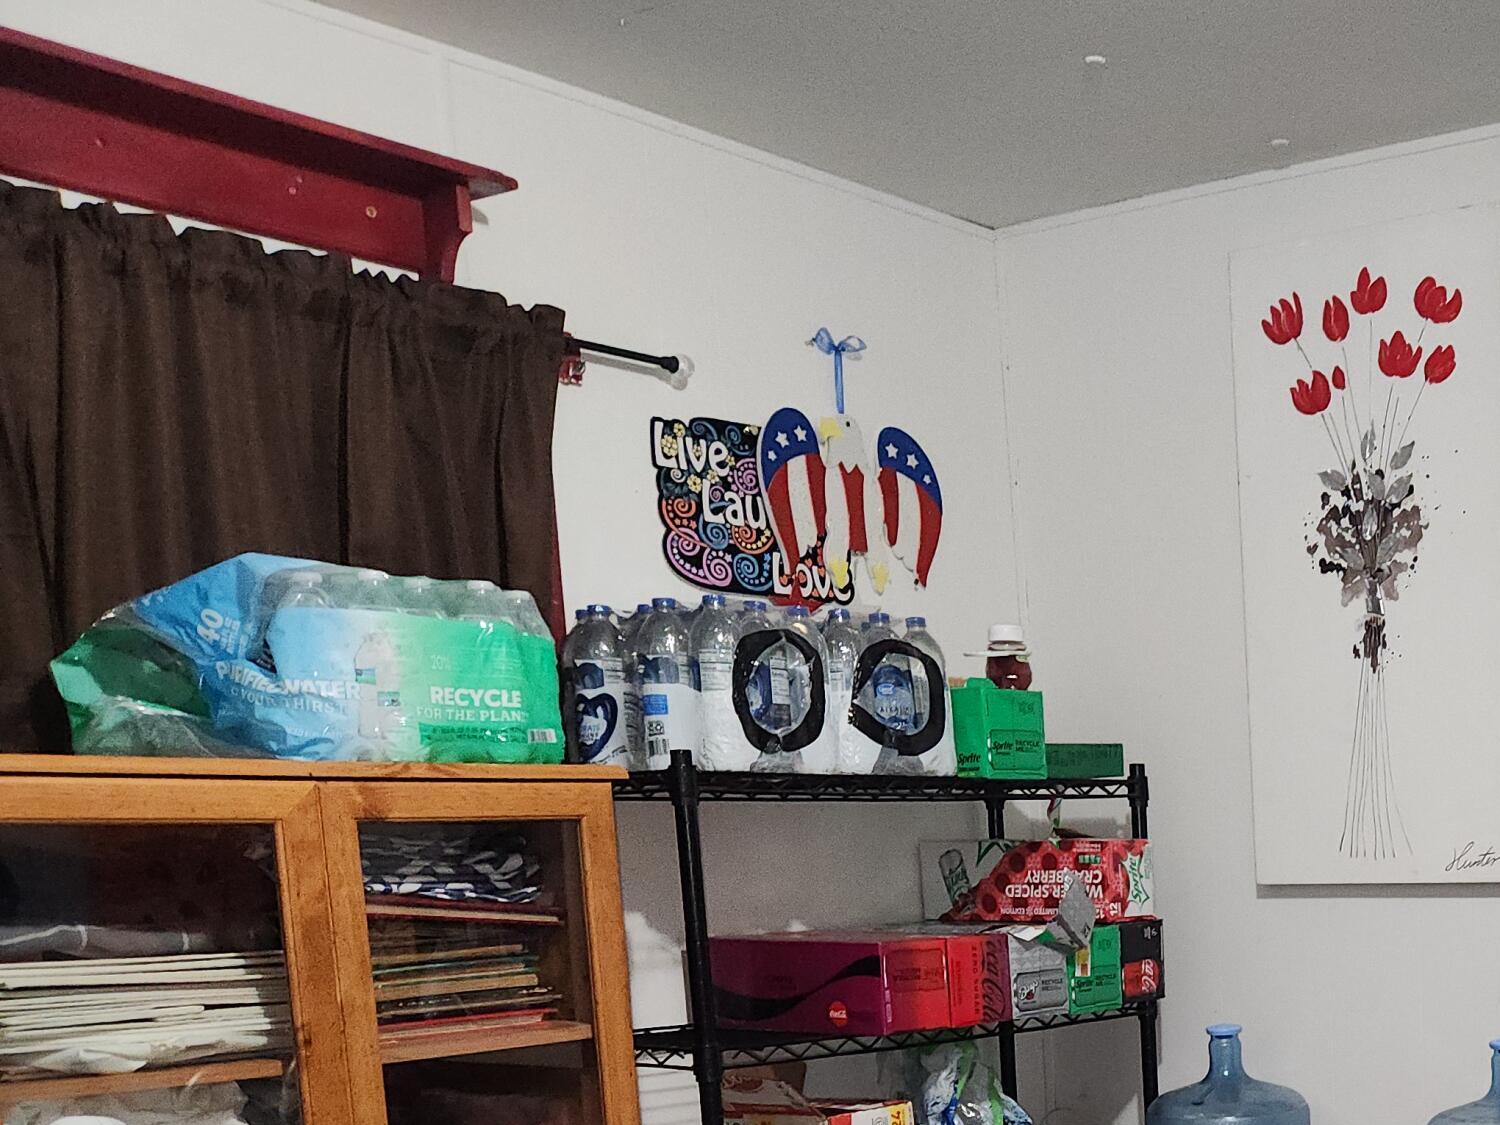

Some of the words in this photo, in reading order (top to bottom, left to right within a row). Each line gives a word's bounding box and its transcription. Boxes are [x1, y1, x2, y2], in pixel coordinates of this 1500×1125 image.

[654, 420, 731, 477] Live
[702, 488, 768, 531] Lau
[771, 550, 855, 604] Love
[429, 686, 522, 708] RECYCLE
[415, 706, 442, 720] FOR
[444, 708, 476, 721] THE
[479, 710, 528, 723] PLAN
[958, 752, 981, 765] Sprite
[1024, 869, 1103, 884] CRABERRY
[1005, 884, 1051, 898] SPICED
